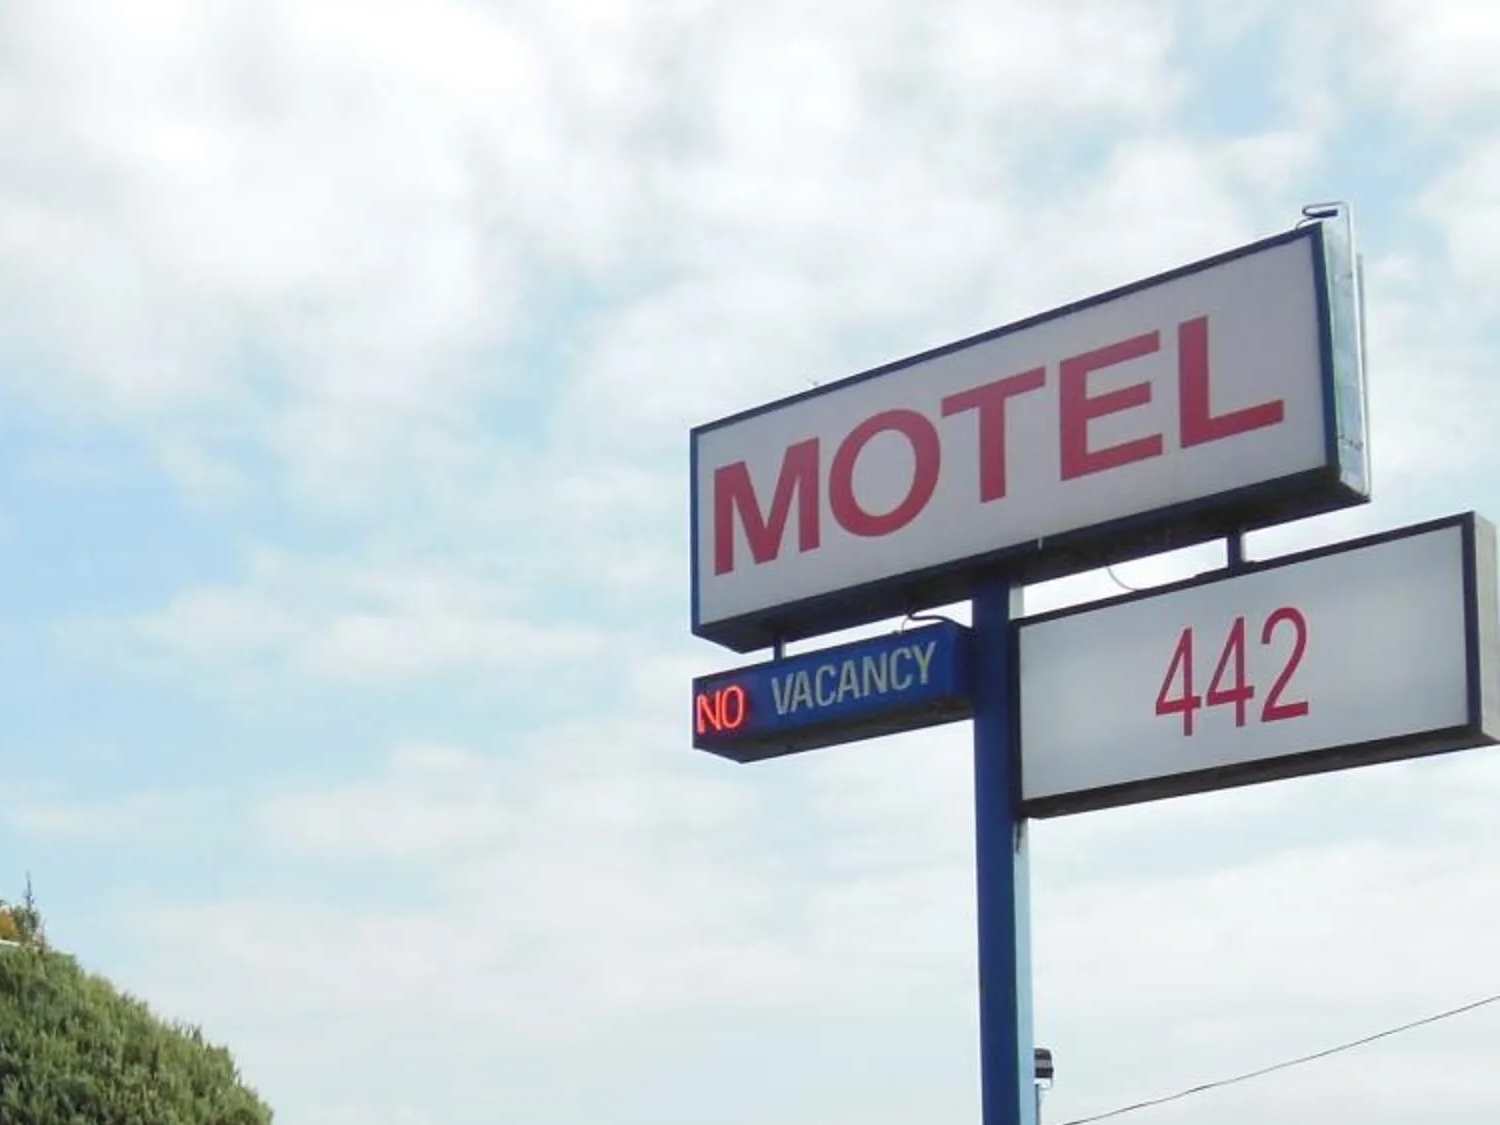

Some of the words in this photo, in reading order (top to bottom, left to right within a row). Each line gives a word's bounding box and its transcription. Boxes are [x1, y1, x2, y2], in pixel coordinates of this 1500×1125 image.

[713, 315, 1285, 576] MOTEL
[695, 684, 745, 734] NO
[771, 640, 938, 716] VACANCY
[1155, 606, 1310, 737] 442
